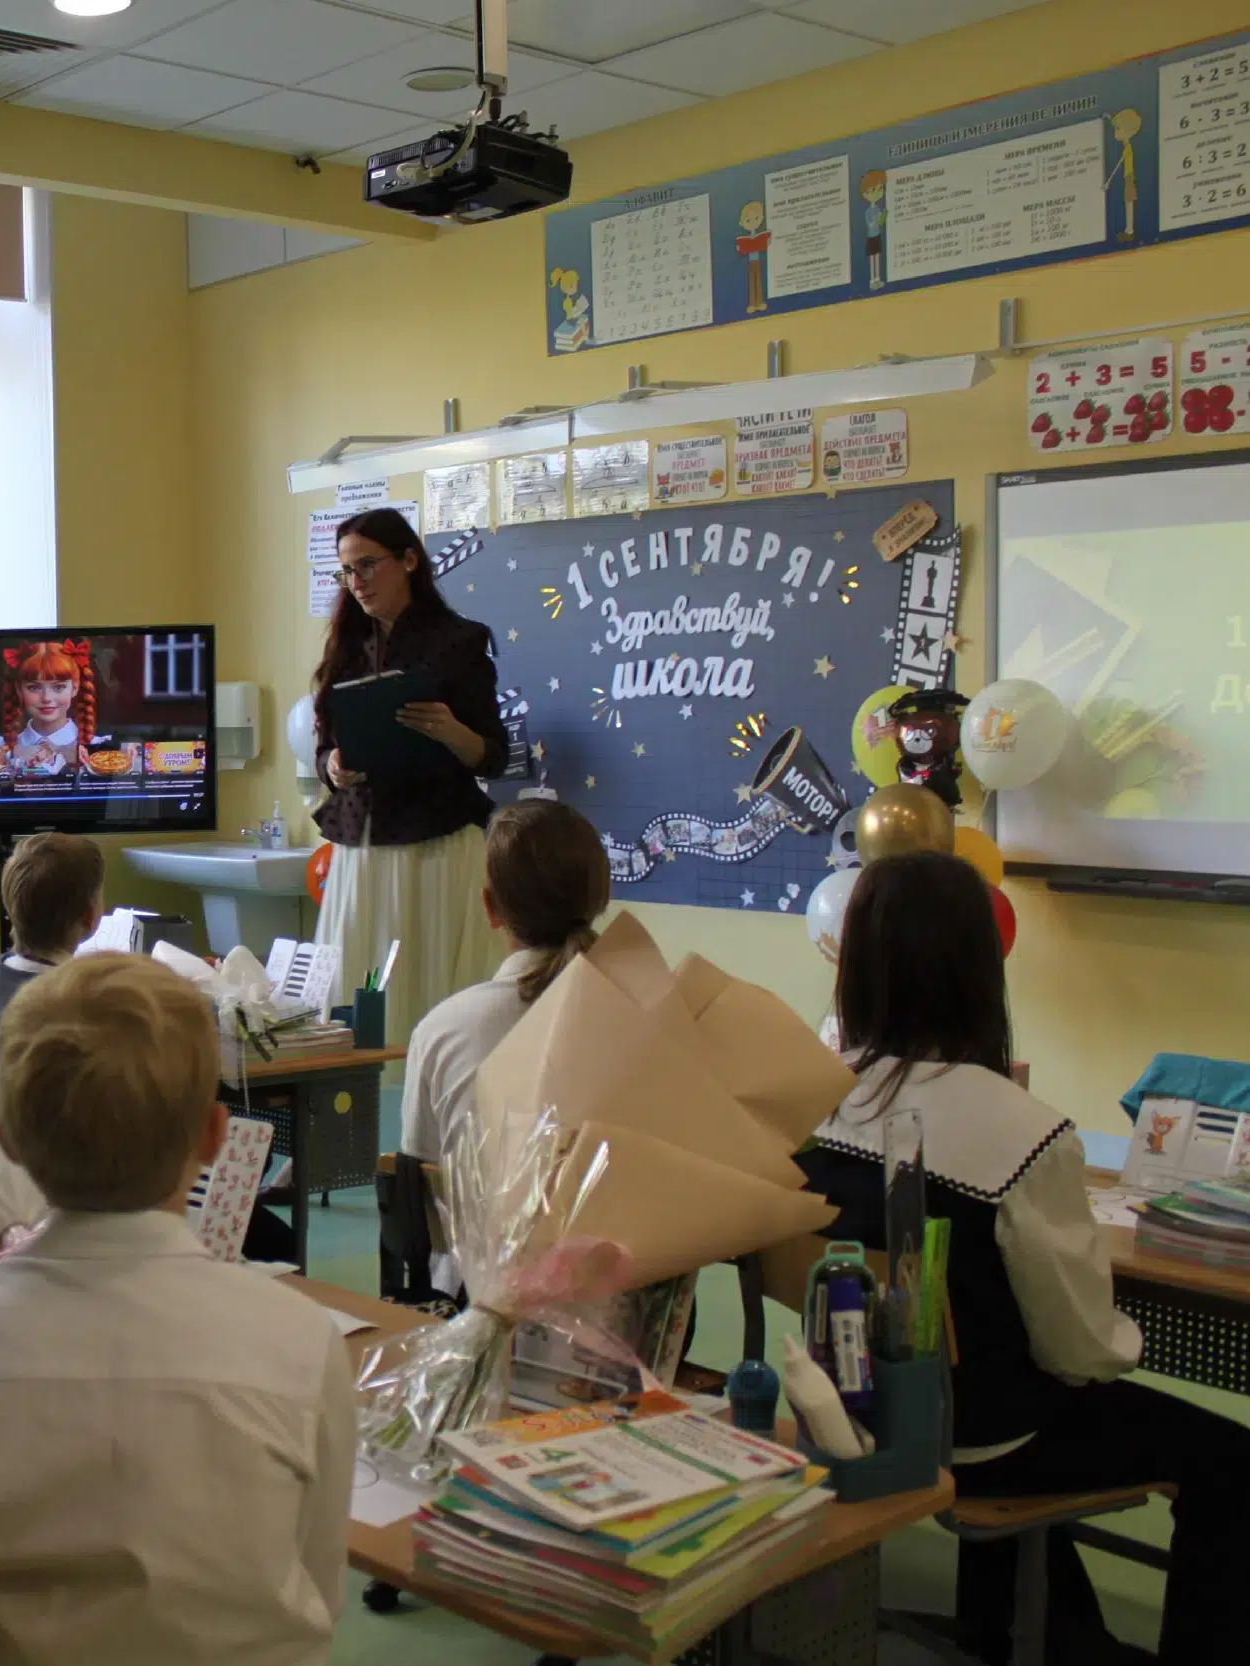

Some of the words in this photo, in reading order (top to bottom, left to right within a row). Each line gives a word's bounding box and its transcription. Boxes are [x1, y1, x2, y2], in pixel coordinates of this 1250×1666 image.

[1181, 75, 1190, 88] 3
[1210, 67, 1219, 81] 2
[1239, 60, 1248, 74] 5
[1180, 116, 1190, 129] 6
[1211, 108, 1220, 121] 3
[1240, 101, 1250, 115] 3
[888, 134, 949, 157] ЕДИНИЦЫ
[951, 115, 1029, 142] ИЗМЕРЕНИЯ
[1182, 156, 1192, 169] 6
[1208, 150, 1218, 164] 3
[1236, 143, 1247, 157] 2
[1182, 194, 1192, 208] 3
[1207, 190, 1217, 203] 2
[1236, 184, 1247, 197] 6
[1035, 372, 1051, 394] 2
[1065, 371, 1081, 387] +
[1095, 364, 1112, 386] 3
[1119, 365, 1135, 378] =
[1151, 356, 1168, 378] 5
[1190, 351, 1207, 373] 5
[771, 444, 812, 458] ПРЕДМЕТА
[864, 431, 906, 445] ПРЕДМЕТА
[567, 562, 594, 610] 1
[599, 523, 836, 603] СЕНТЯБРЯ!
[600, 591, 775, 653] Здравствуй,
[1225, 615, 1247, 648] 1
[611, 655, 755, 700] школа
[1210, 674, 1250, 714] Д
[782, 766, 839, 825] МОТОР!
